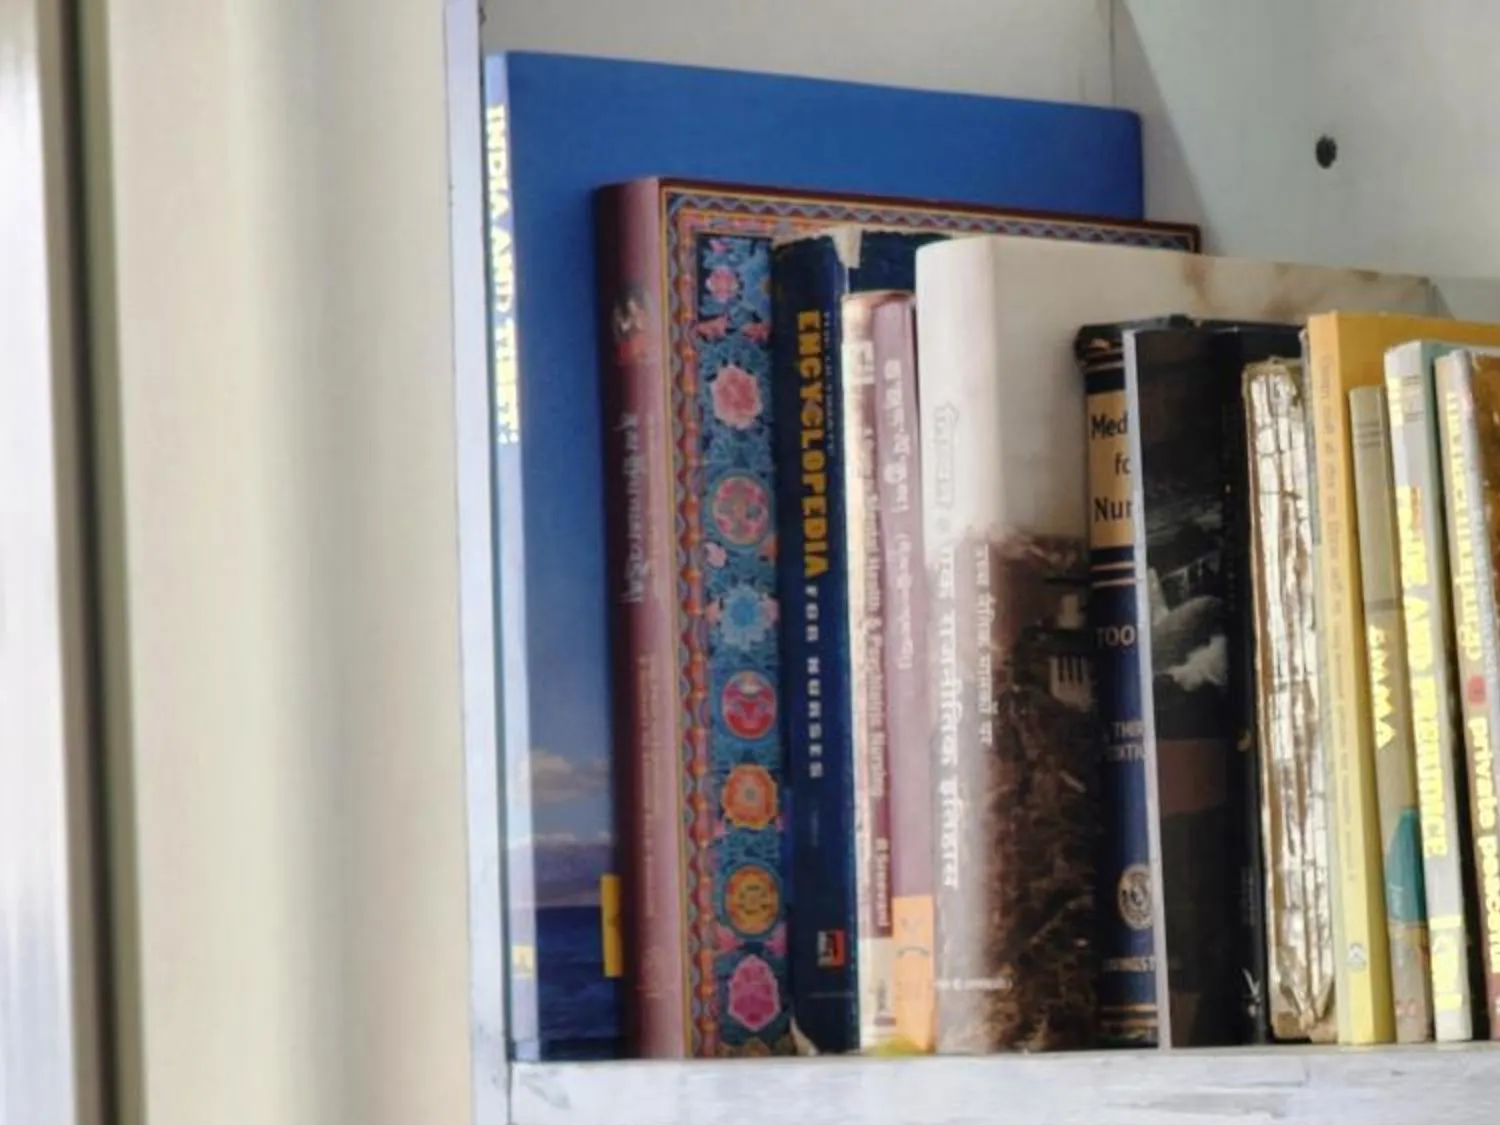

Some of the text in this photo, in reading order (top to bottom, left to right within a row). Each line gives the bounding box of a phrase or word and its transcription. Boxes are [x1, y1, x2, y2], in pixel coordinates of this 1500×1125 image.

[485, 103, 510, 220] INDIA
[491, 224, 515, 313] AND
[797, 309, 829, 579] ENCYCLOPEDIA
[1091, 411, 1129, 441] Med
[1094, 497, 1133, 523] Nur
[804, 584, 819, 644] FOR
[807, 655, 825, 779] NURSES
[1468, 717, 1499, 830] private
